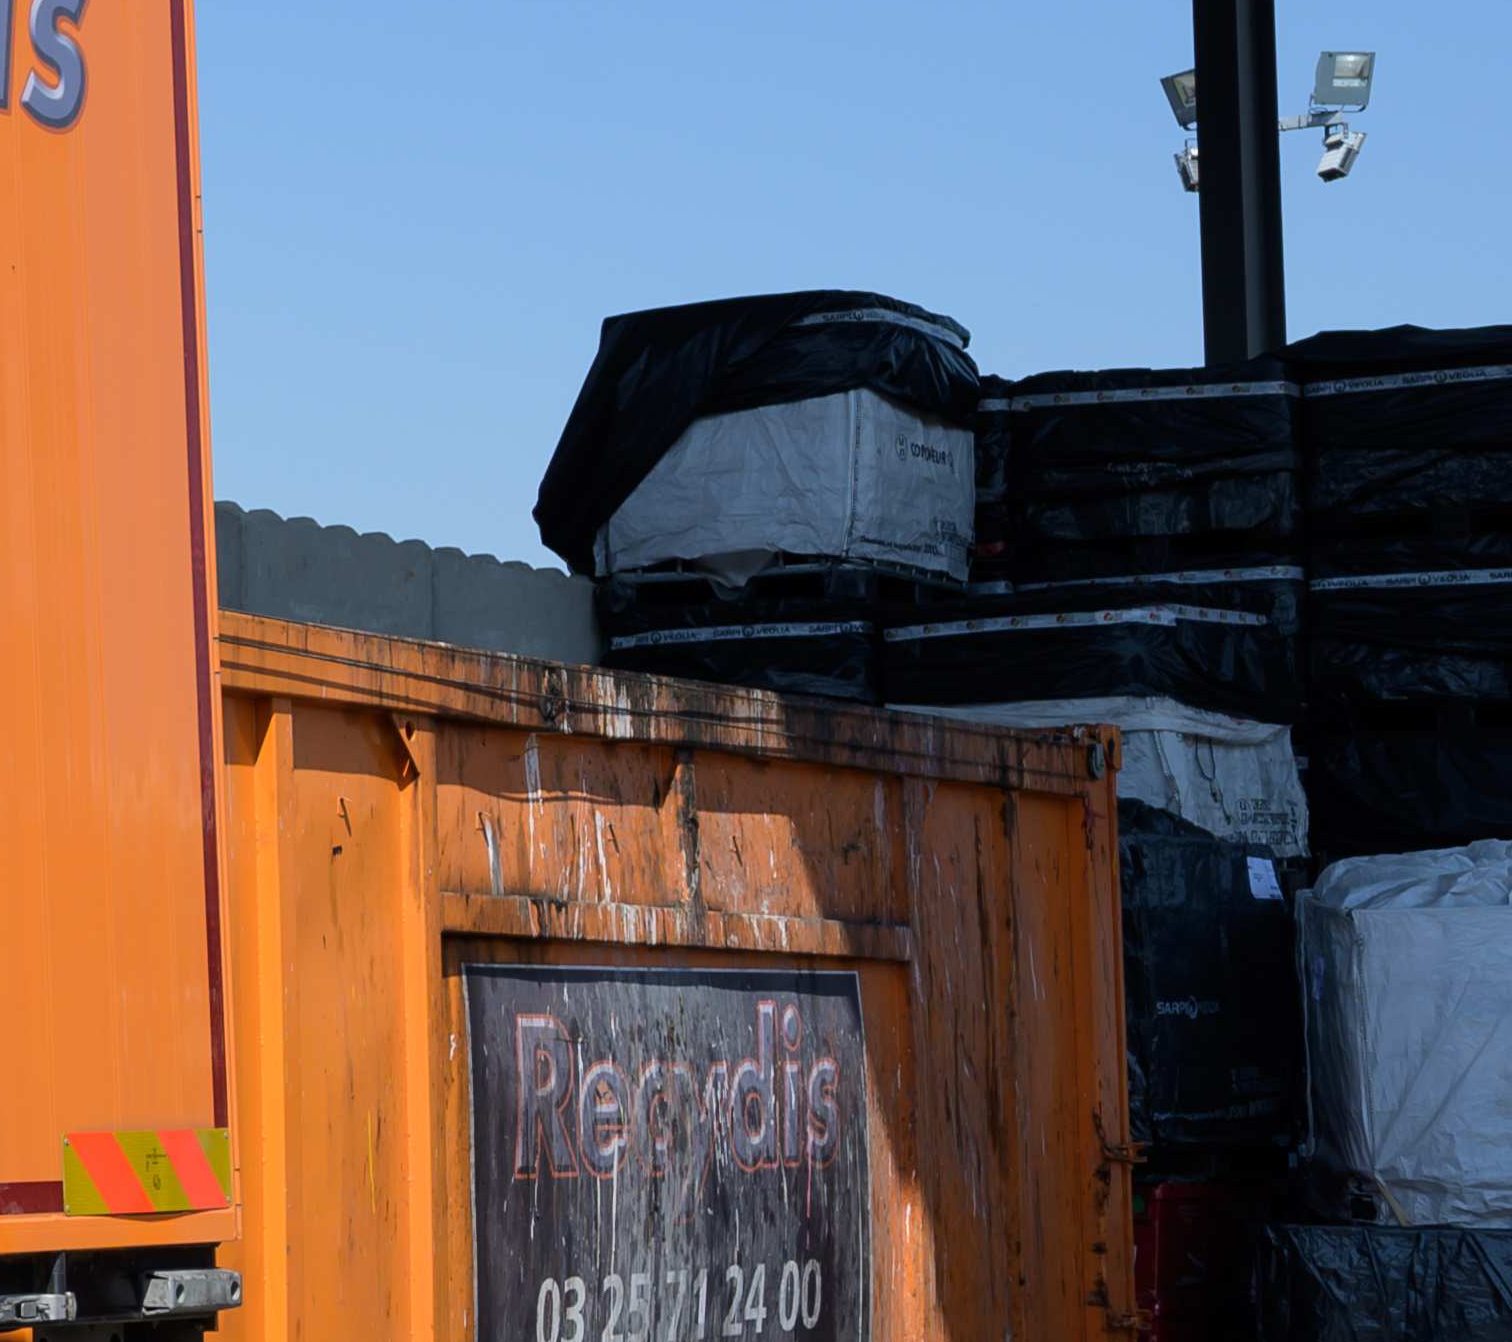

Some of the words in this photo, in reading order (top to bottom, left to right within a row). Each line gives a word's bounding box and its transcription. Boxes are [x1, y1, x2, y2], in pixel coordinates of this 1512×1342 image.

[1156, 1001, 1188, 1015] SARPI
[514, 1000, 841, 1223] Recydis
[666, 1268, 709, 1342] 71
[723, 1263, 767, 1337] 24
[779, 1258, 822, 1332] 00
